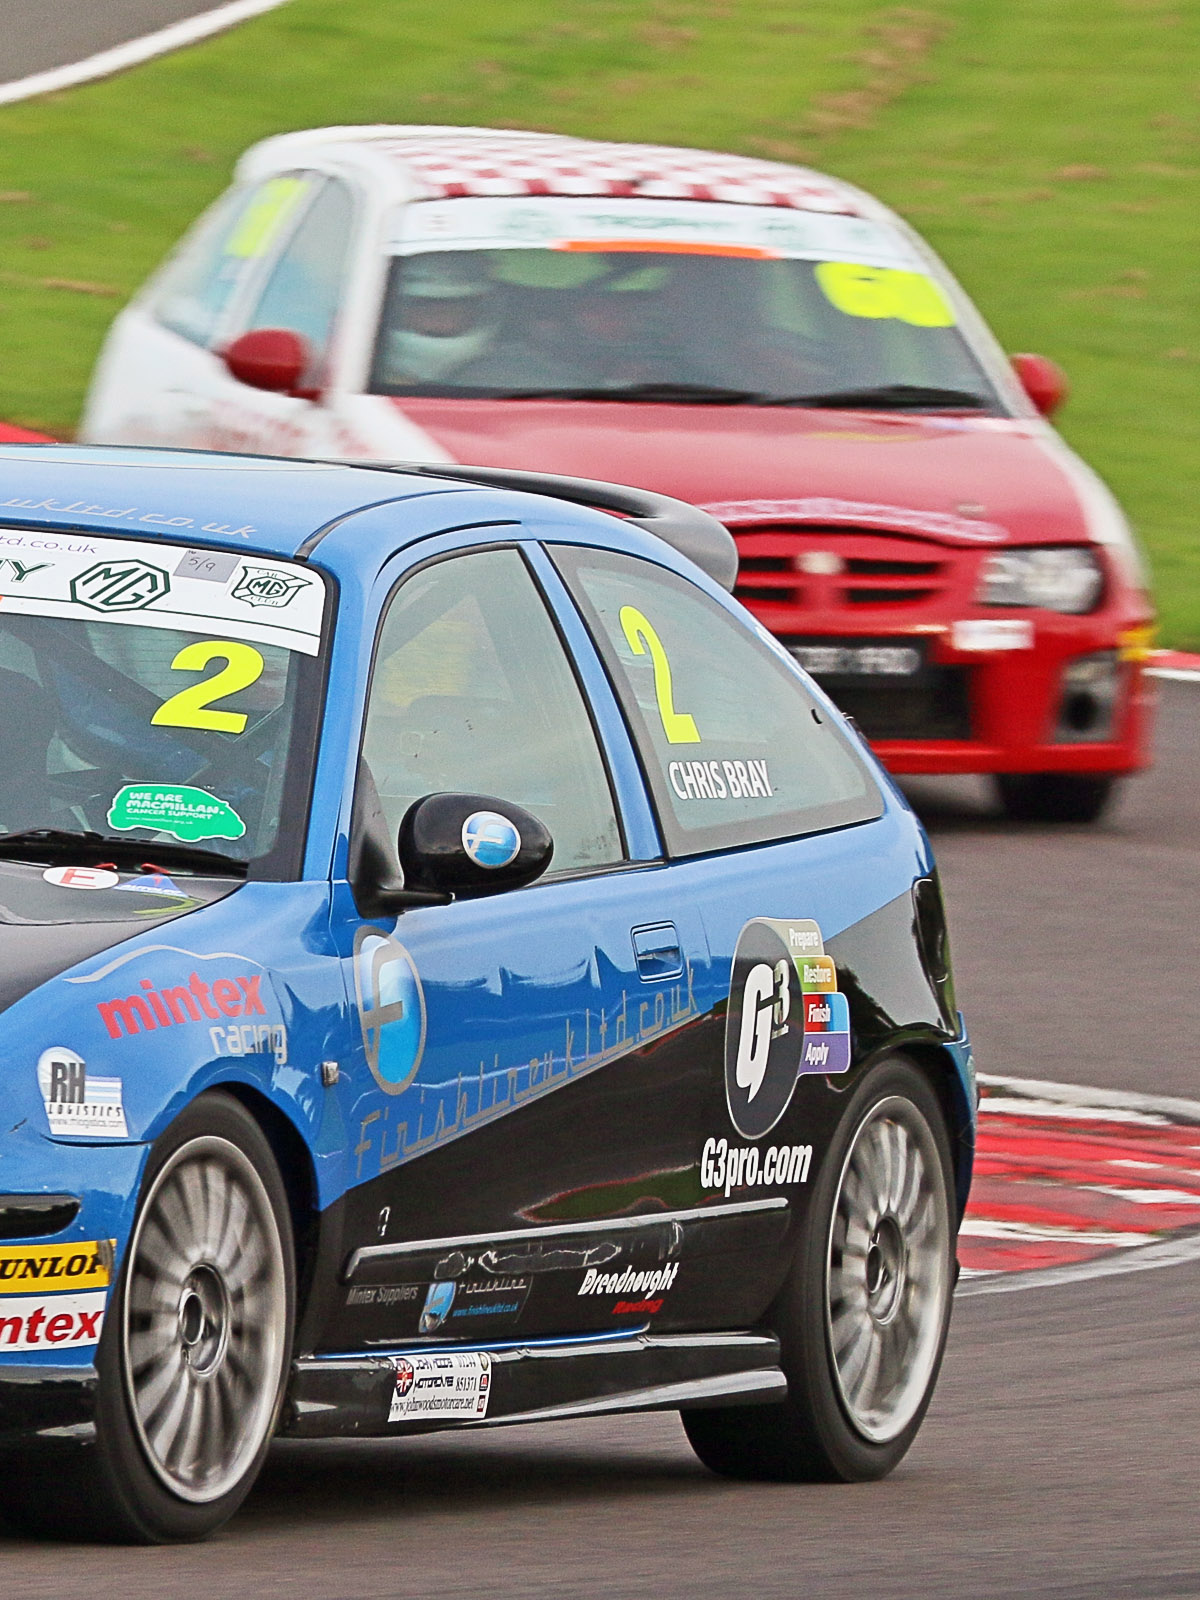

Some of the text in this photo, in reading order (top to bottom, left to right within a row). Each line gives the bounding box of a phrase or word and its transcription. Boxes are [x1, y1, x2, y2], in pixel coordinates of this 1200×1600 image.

[77, 563, 164, 609] MG
[252, 579, 283, 595] MG
[619, 605, 701, 744] 2
[151, 640, 265, 734] 2
[669, 760, 773, 799] CHRIS BRAY
[129, 792, 184, 803] WE ARE
[126, 808, 213, 820] CANCER SUPPORT
[60, 868, 104, 888] E
[789, 927, 819, 950] Prepare
[803, 964, 832, 984] Restore
[97, 971, 267, 1039] mintex
[808, 1003, 831, 1023] Finish
[209, 1024, 288, 1065] racing
[805, 1042, 829, 1066] Apply
[50, 1061, 86, 1104] RH
[48, 1104, 122, 1117] LOGISTICS
[700, 1137, 813, 1198] G3pro.com
[578, 1262, 679, 1300] Dreadnought
[377, 1286, 418, 1306] Suppliers
